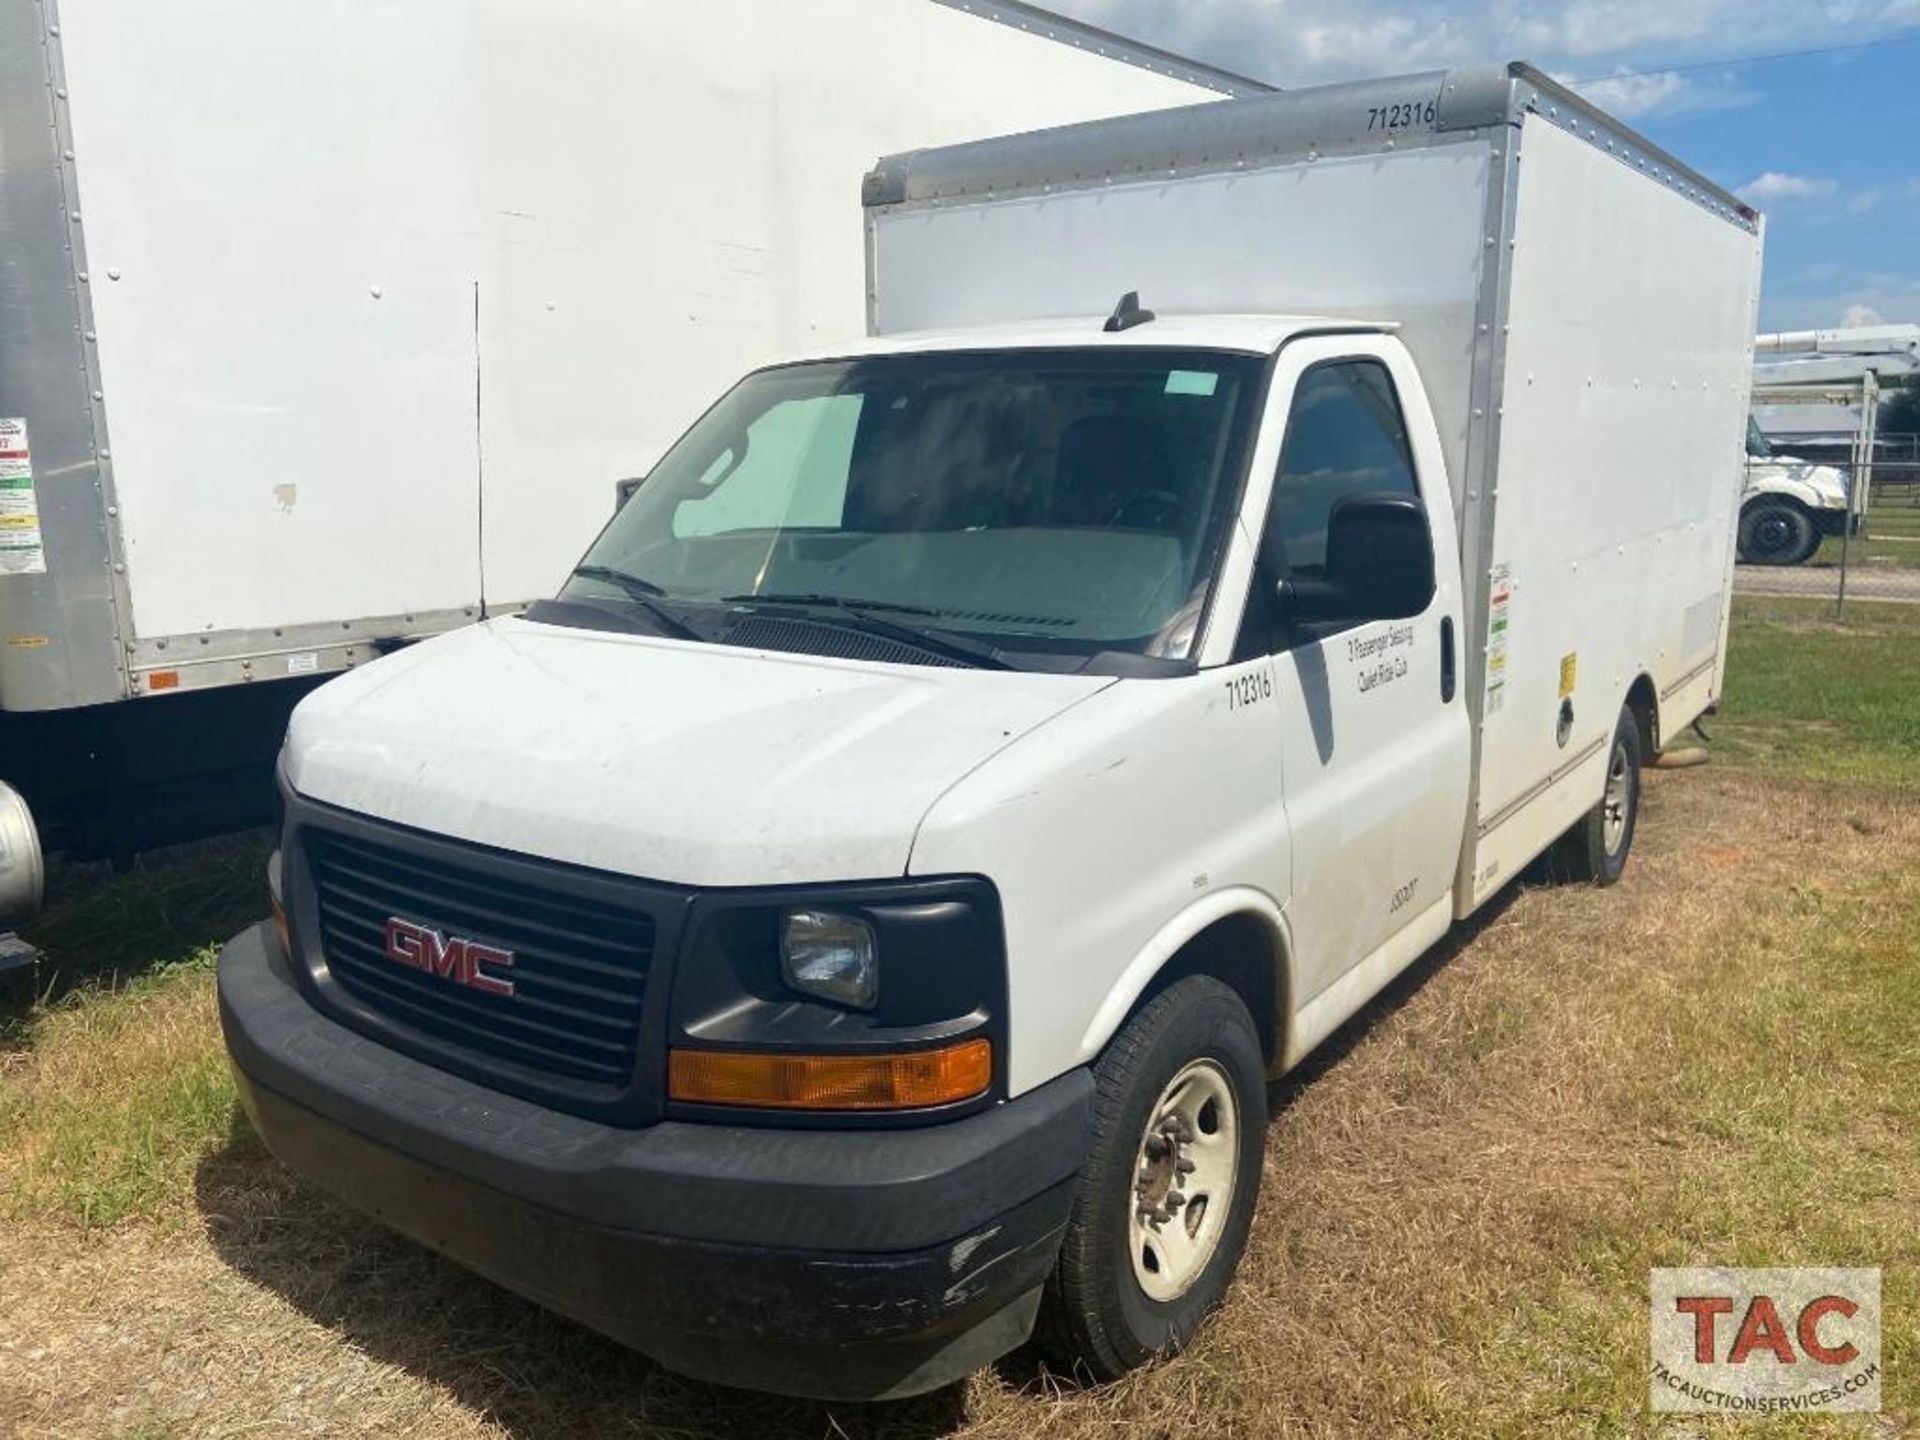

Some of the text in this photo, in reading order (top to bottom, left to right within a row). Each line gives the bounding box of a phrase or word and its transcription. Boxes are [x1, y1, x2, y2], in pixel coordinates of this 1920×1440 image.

[1367, 101, 1436, 132] 712316
[1225, 668, 1272, 711] 712316
[386, 916, 515, 997] GMC
